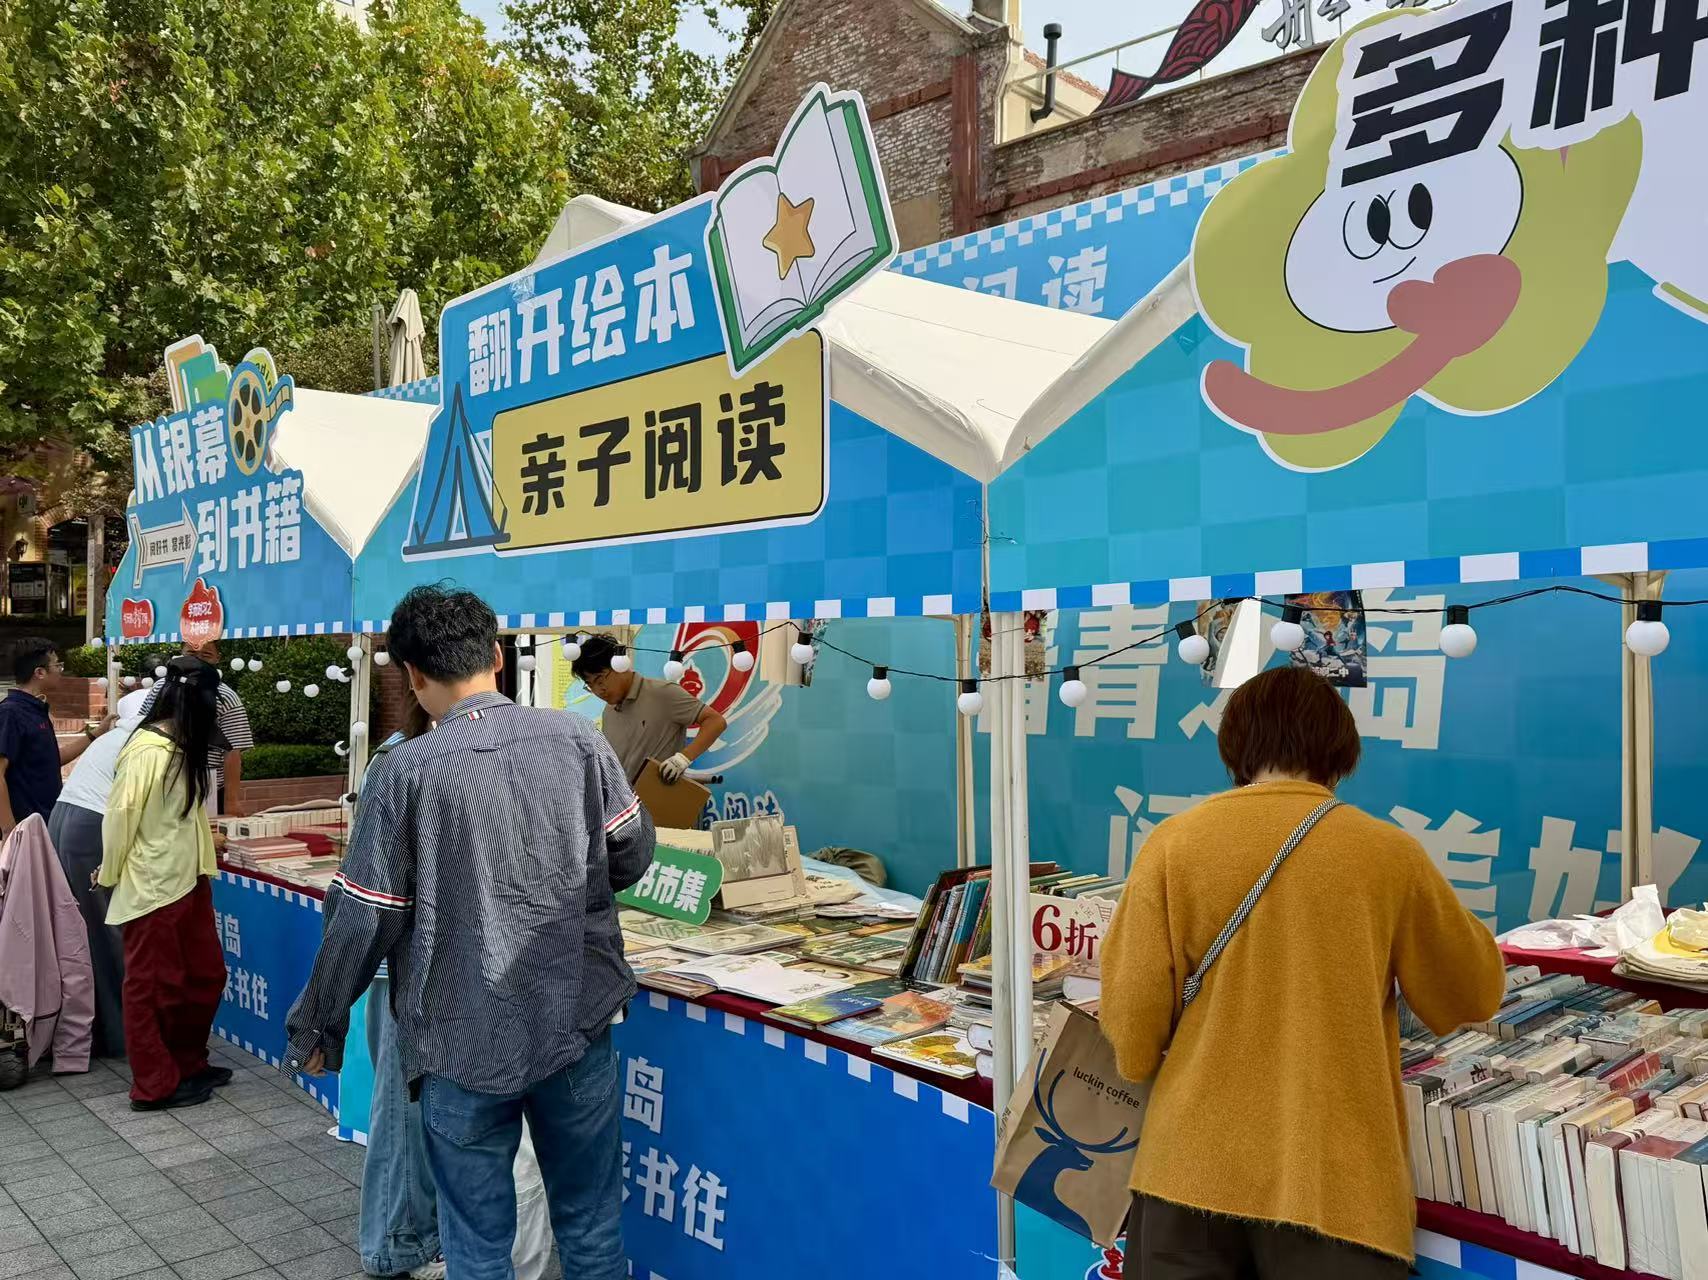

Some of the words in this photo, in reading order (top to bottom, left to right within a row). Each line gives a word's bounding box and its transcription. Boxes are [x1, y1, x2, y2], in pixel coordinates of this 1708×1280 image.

[467, 244, 695, 397] 翻开绘本
[133, 406, 229, 504] 从银幕
[519, 381, 786, 516] 亲子阅读
[197, 477, 302, 574] 到书籍
[1032, 904, 1099, 960] 6折
[1072, 1066, 1105, 1090] luckin
[1106, 1085, 1140, 1109] coffee
[622, 1141, 728, 1251] 书往
